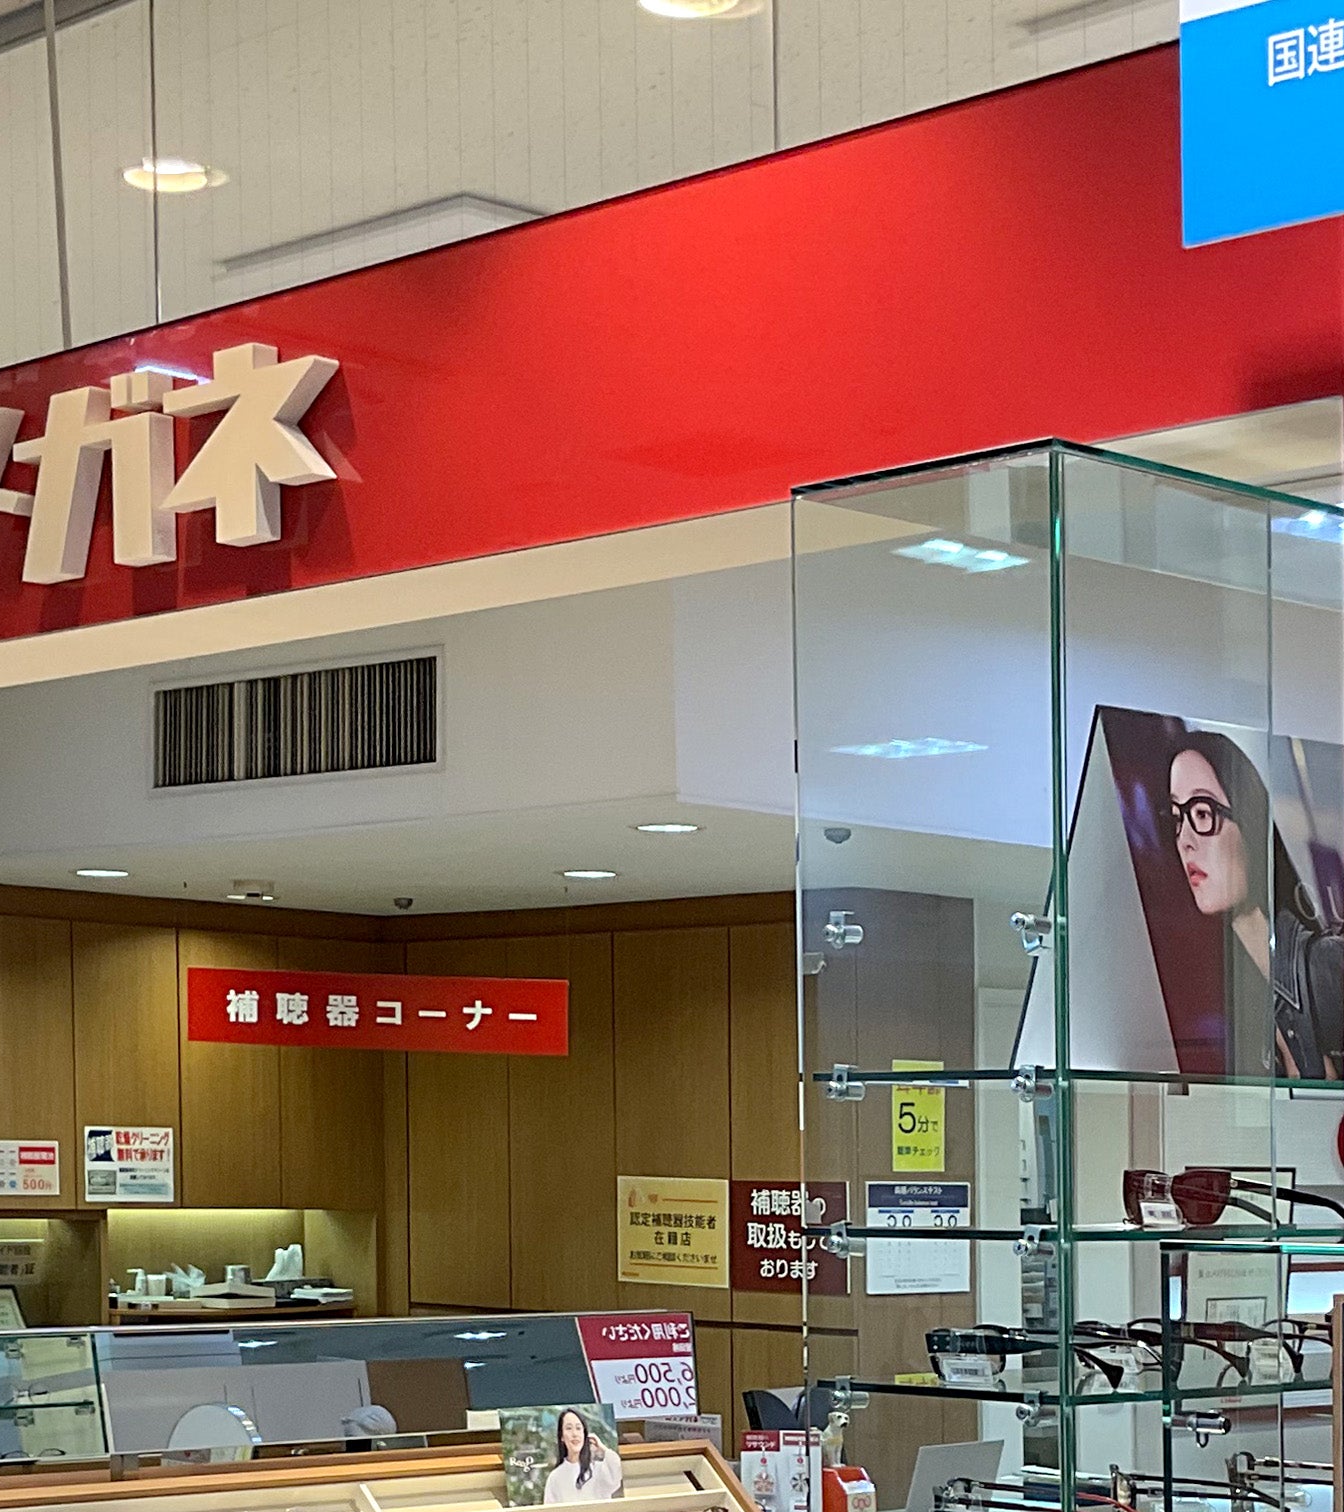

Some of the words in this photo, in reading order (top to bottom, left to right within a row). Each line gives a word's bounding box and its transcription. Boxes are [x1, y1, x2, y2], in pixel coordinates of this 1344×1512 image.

[226, 989, 538, 1032] 補聴器コーナー
[897, 1101, 939, 1134] 5分で
[759, 1258, 819, 1280] おります
